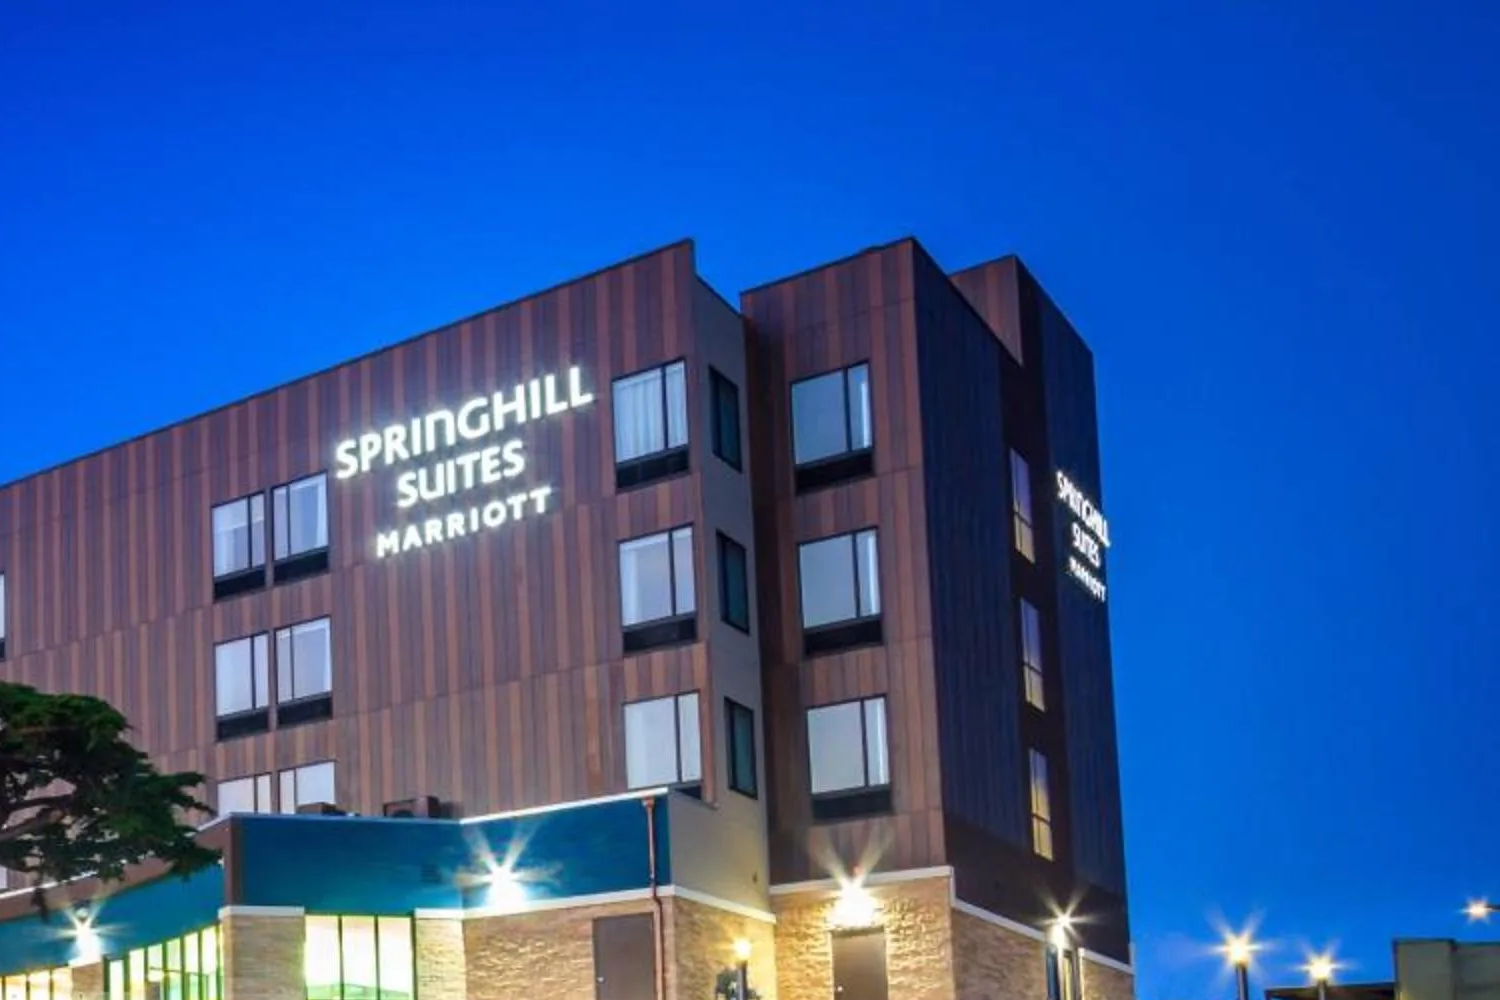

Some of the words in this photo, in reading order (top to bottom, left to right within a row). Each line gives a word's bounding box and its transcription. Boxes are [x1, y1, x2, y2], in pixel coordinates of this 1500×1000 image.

[334, 366, 594, 479] SPRINGHILL
[397, 439, 526, 508] SUITES
[375, 486, 552, 558] MARRIOTT
